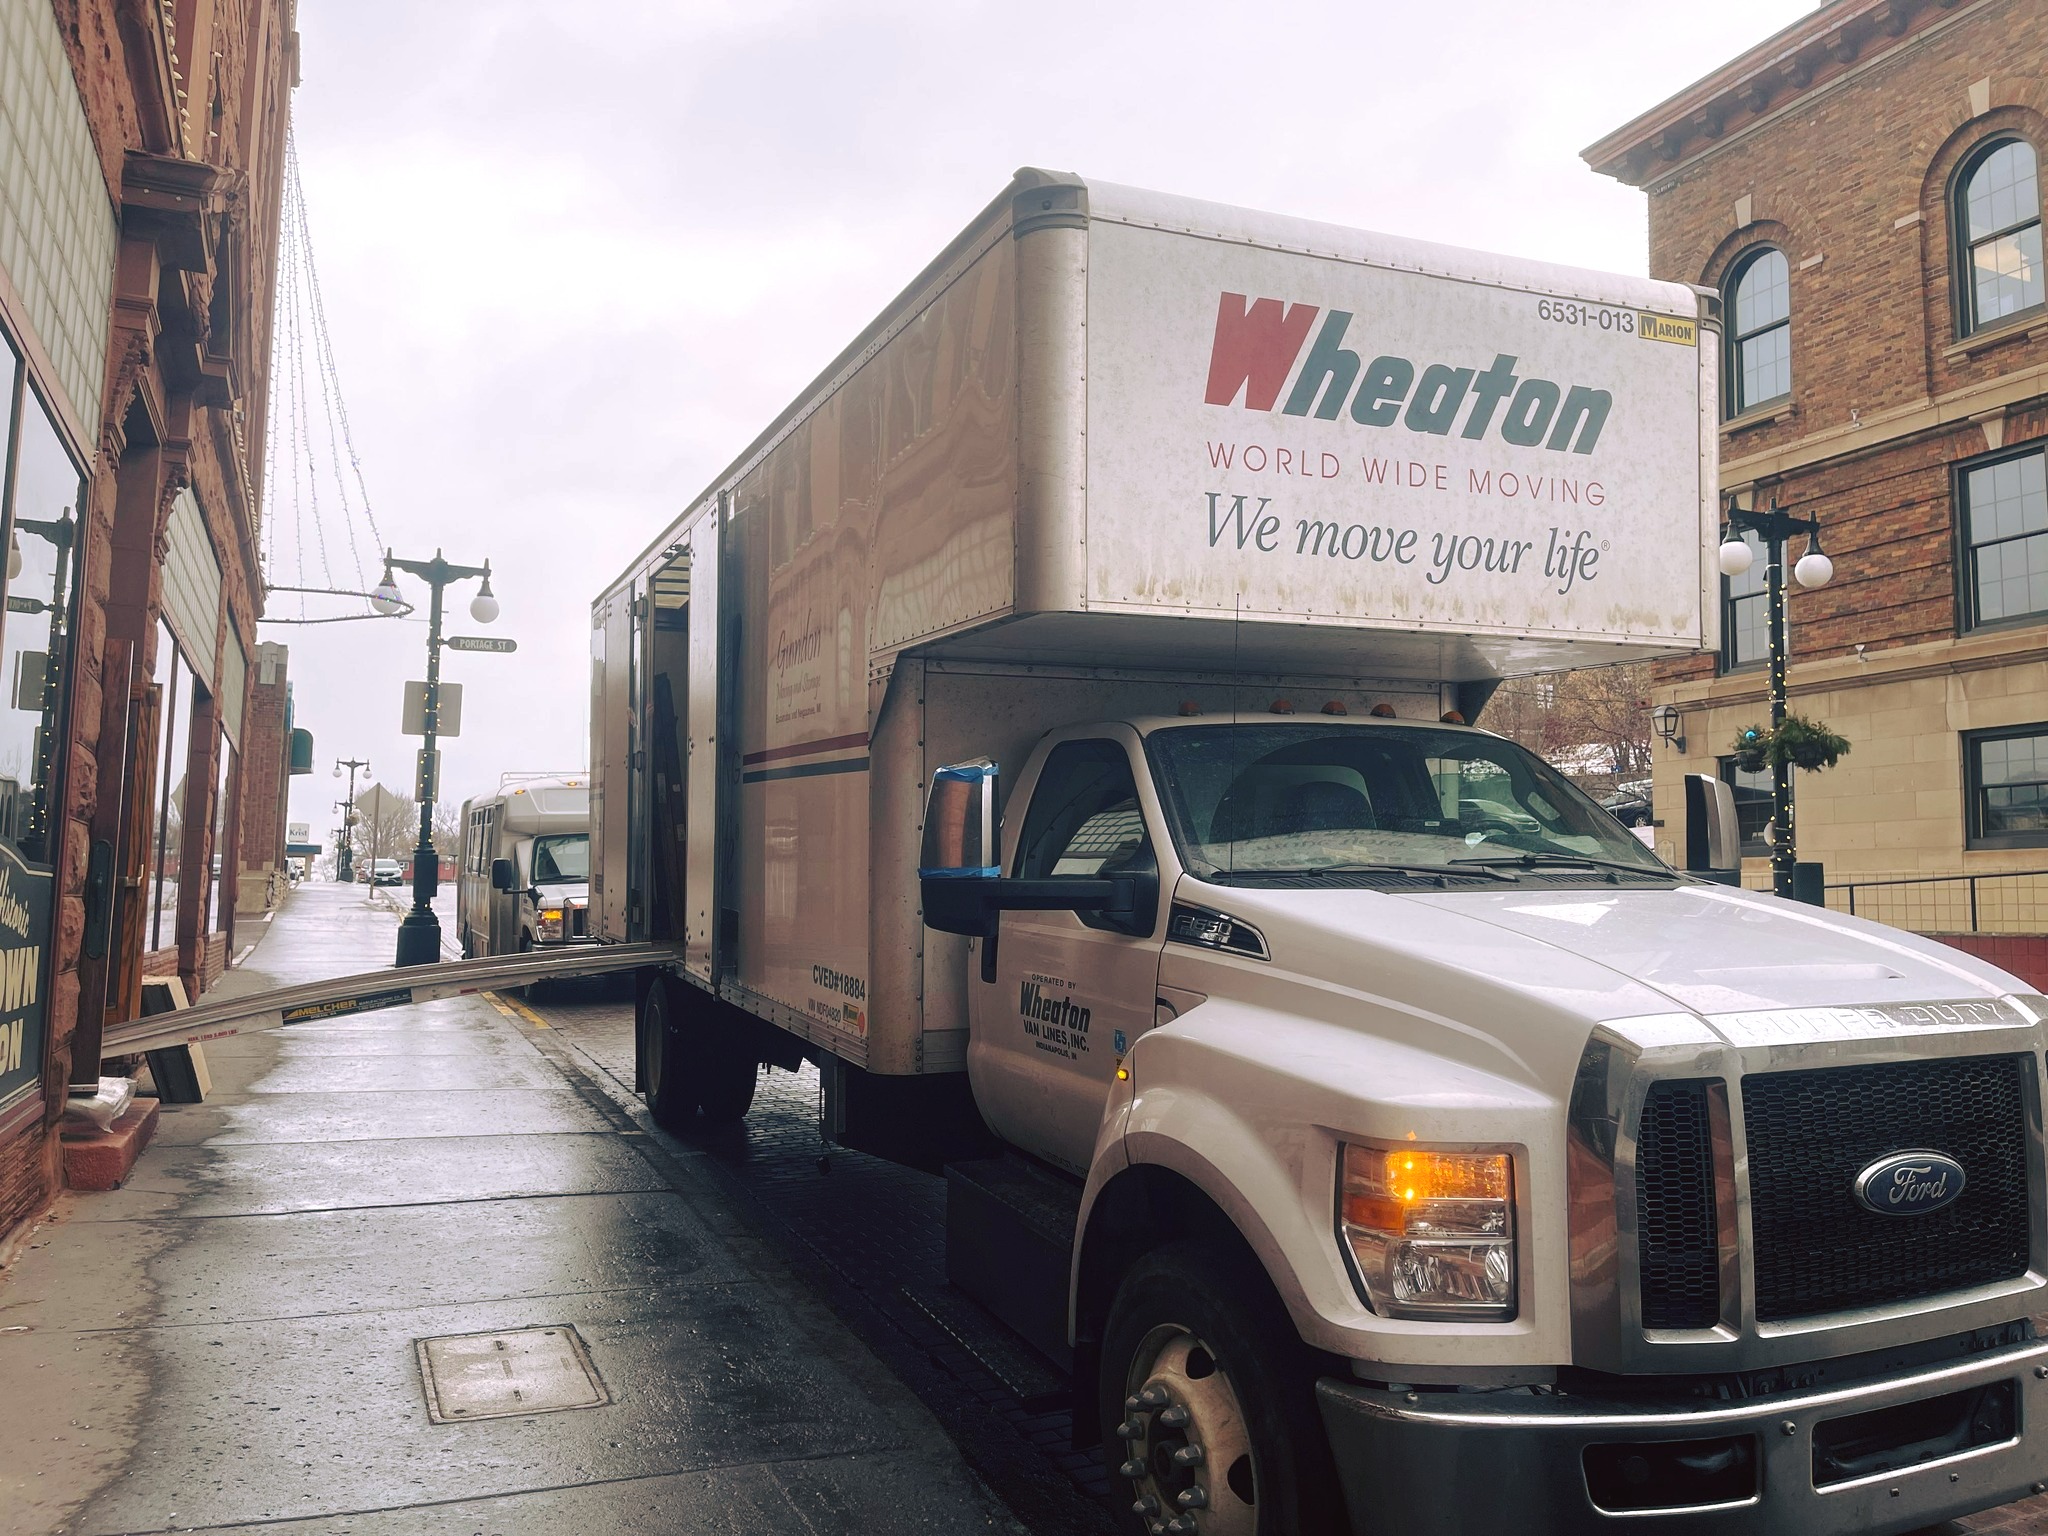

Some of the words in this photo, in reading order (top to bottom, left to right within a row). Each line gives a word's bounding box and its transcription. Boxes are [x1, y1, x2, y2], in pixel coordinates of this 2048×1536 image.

[1537, 299, 1634, 334] 6531-013
[1640, 315, 1692, 340] MARION
[1204, 291, 1612, 456] Wheaton
[1207, 441, 1340, 481] WORLD
[1362, 456, 1449, 492] WIDE
[1468, 468, 1606, 507] MOVING
[1204, 491, 1281, 553] We
[1295, 517, 1419, 565] move
[1425, 531, 1533, 586] your
[459, 639, 494, 651] PORTAGE
[497, 641, 507, 651] ST
[290, 829, 307, 837] Krist
[812, 964, 866, 1001] CVED#18884
[1031, 973, 1064, 987] OPERATED
[1067, 981, 1077, 990] BY
[1020, 981, 1091, 1033] Wheaton
[1736, 1006, 1898, 1037] SUPER
[1899, 1003, 2005, 1025] DUTY
[1023, 1019, 1040, 1037] VAN
[1888, 1165, 1947, 1204] Ford
